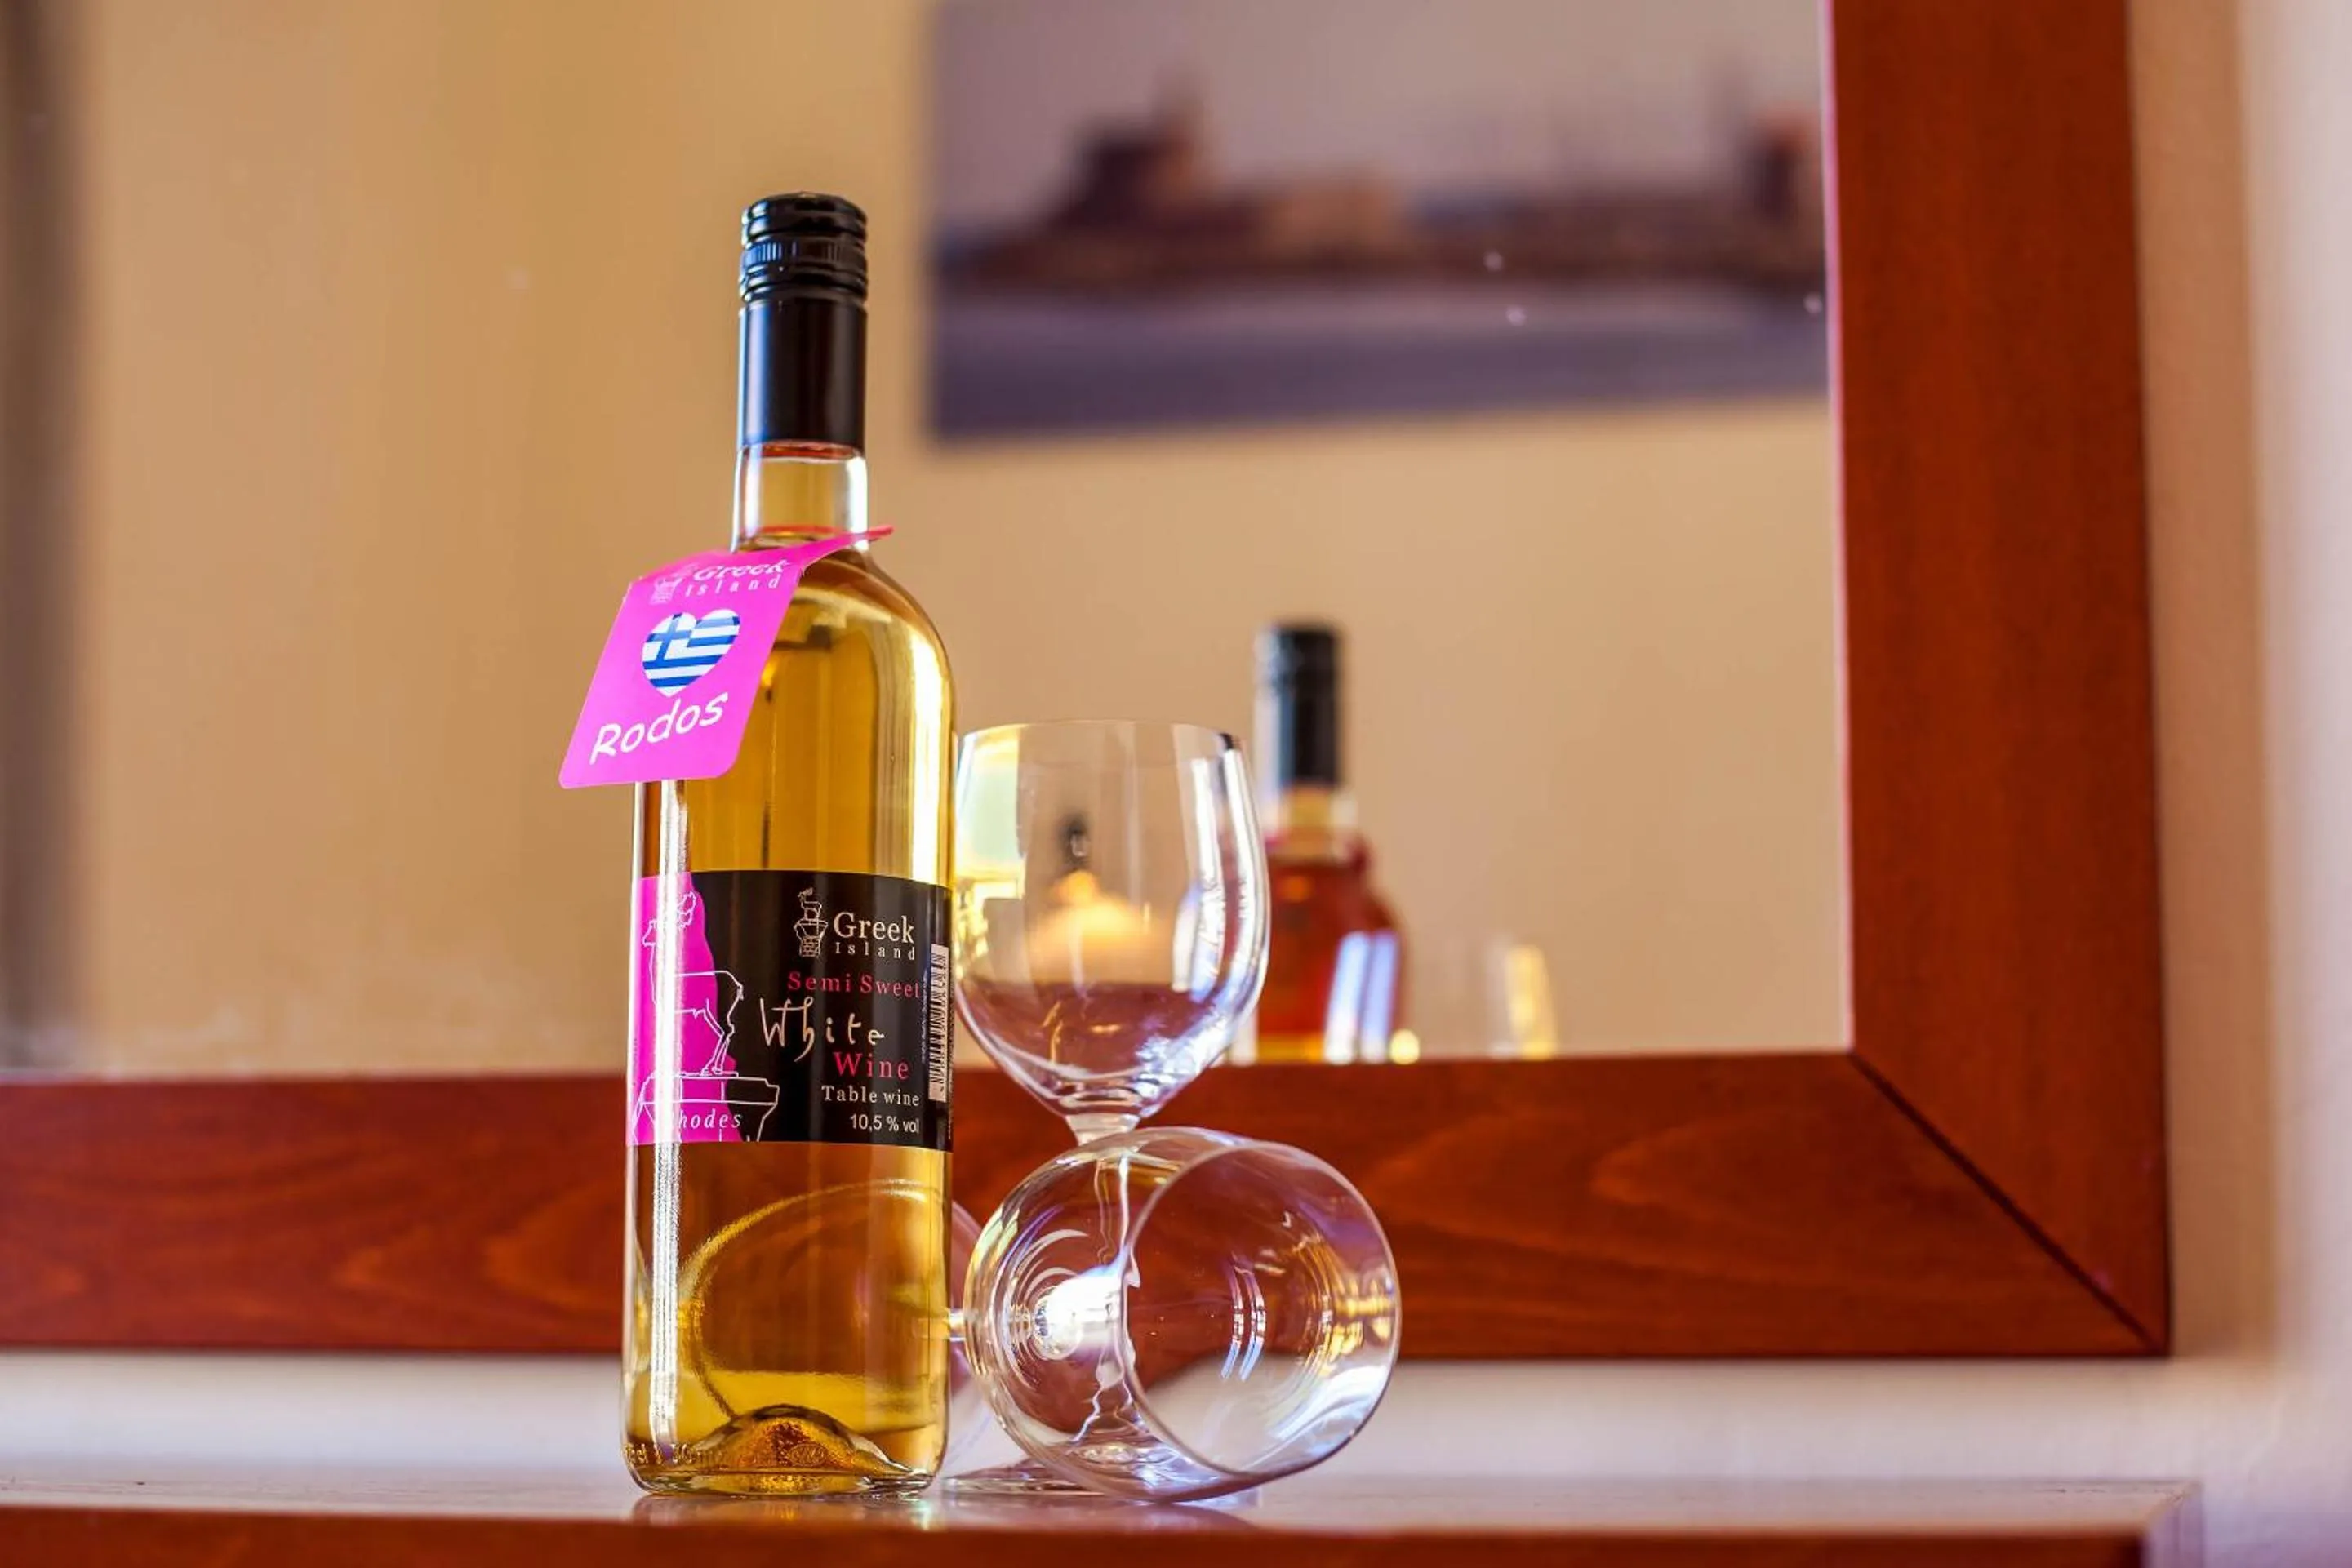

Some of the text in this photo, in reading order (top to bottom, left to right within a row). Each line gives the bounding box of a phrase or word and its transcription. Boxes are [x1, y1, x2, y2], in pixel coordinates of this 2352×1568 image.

[694, 559, 790, 580] Greek
[685, 574, 781, 597] Island
[589, 691, 729, 766] Rodos
[833, 911, 915, 944] Greek
[835, 941, 916, 961] Island
[787, 971, 921, 999] Semi Sweet
[759, 996, 886, 1062] White
[832, 1051, 910, 1080] Wine
[820, 1085, 920, 1107] Table wine
[671, 1108, 742, 1129] hodes
[849, 1113, 920, 1135] 10,5 % vol
